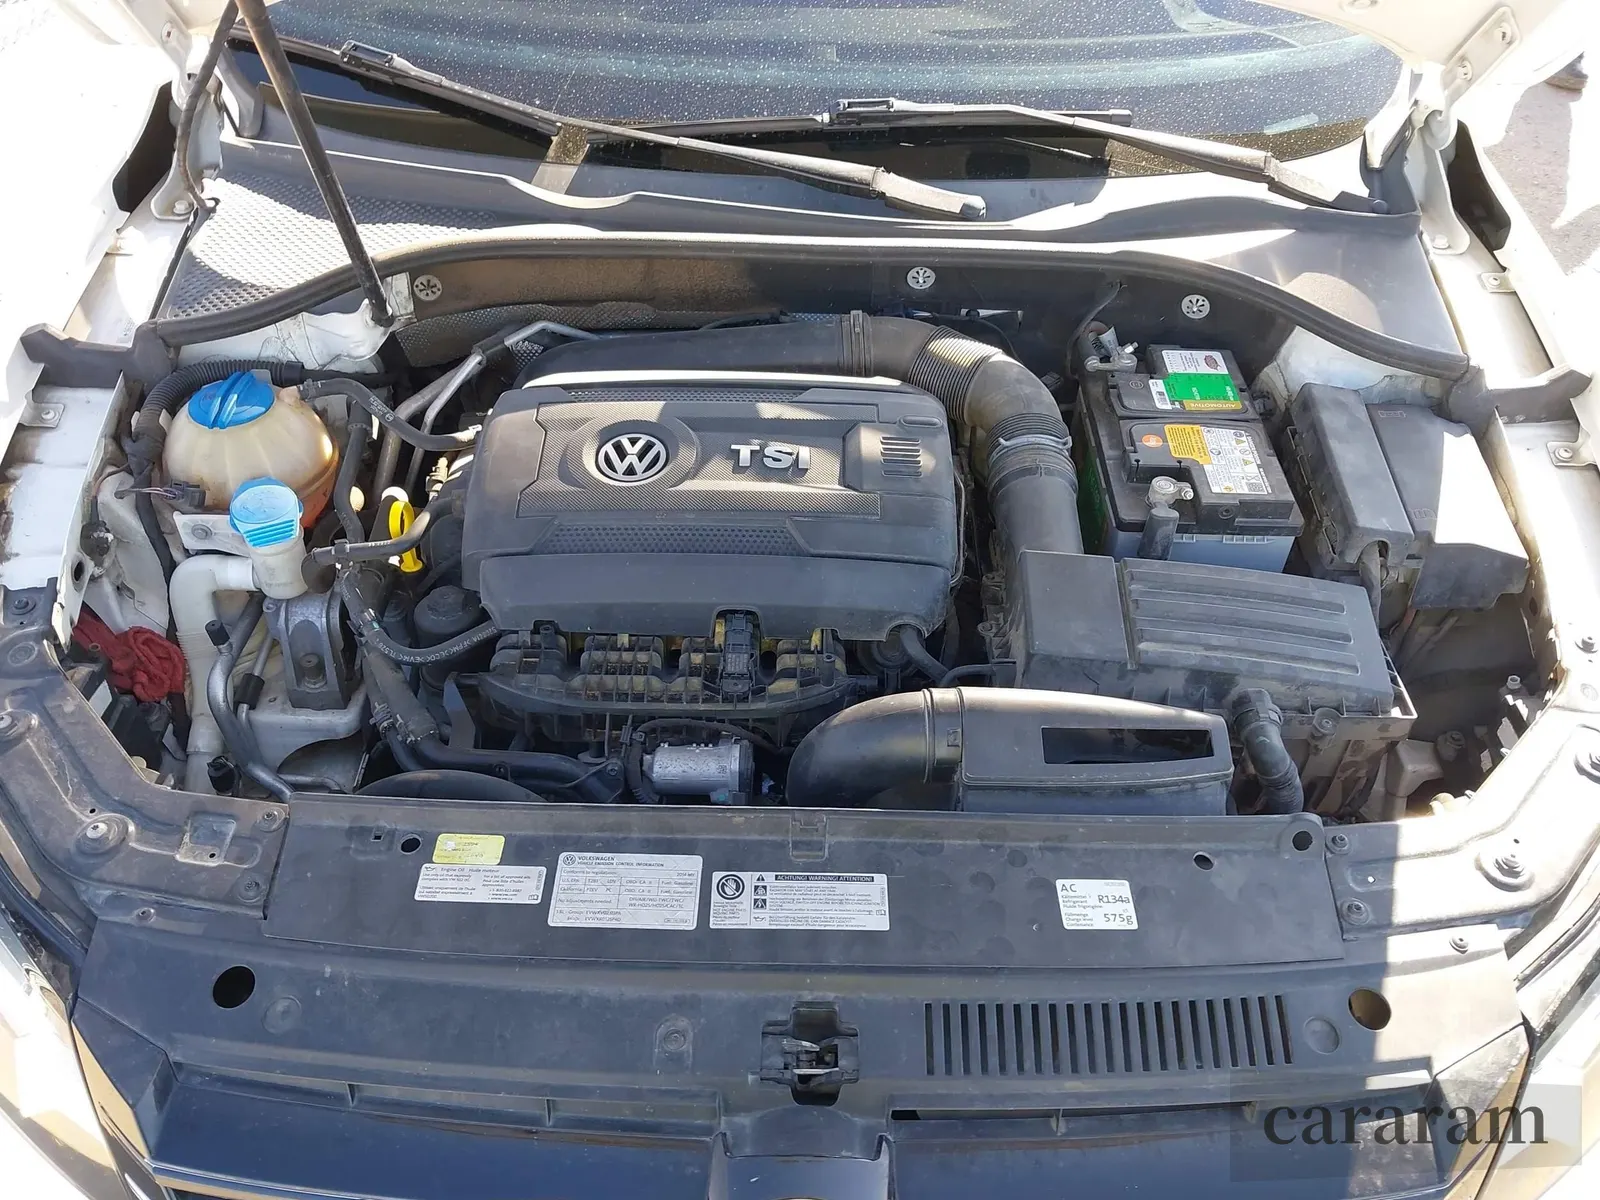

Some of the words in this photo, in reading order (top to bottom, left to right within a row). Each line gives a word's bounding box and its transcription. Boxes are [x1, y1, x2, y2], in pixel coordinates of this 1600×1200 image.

[730, 444, 811, 469] TSI
[1061, 884, 1077, 892] AC
[1097, 895, 1131, 904] R134a
[1104, 913, 1134, 926] 575g
